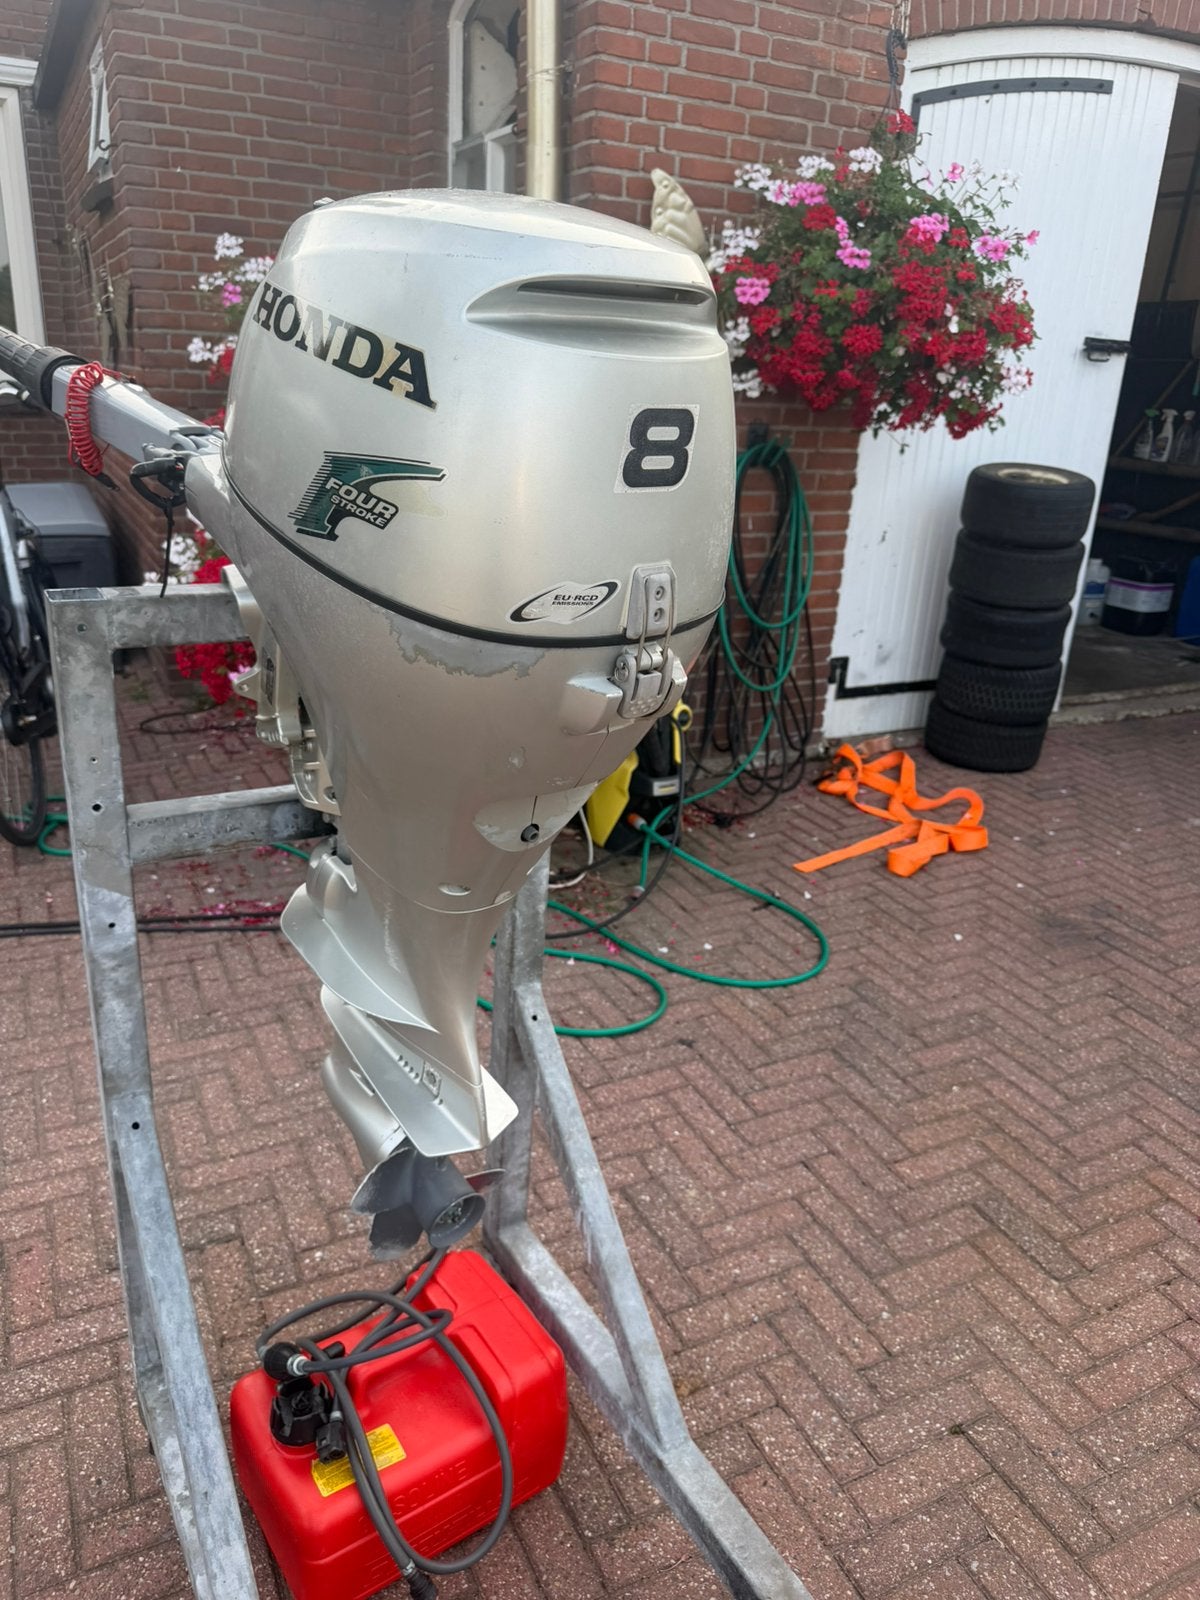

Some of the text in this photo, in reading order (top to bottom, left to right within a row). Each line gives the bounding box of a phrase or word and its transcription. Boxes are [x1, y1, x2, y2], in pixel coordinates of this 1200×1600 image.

[253, 282, 437, 411] HONDA
[622, 408, 695, 488] 8
[325, 477, 397, 519] FOUR
[330, 494, 388, 527] STROKE
